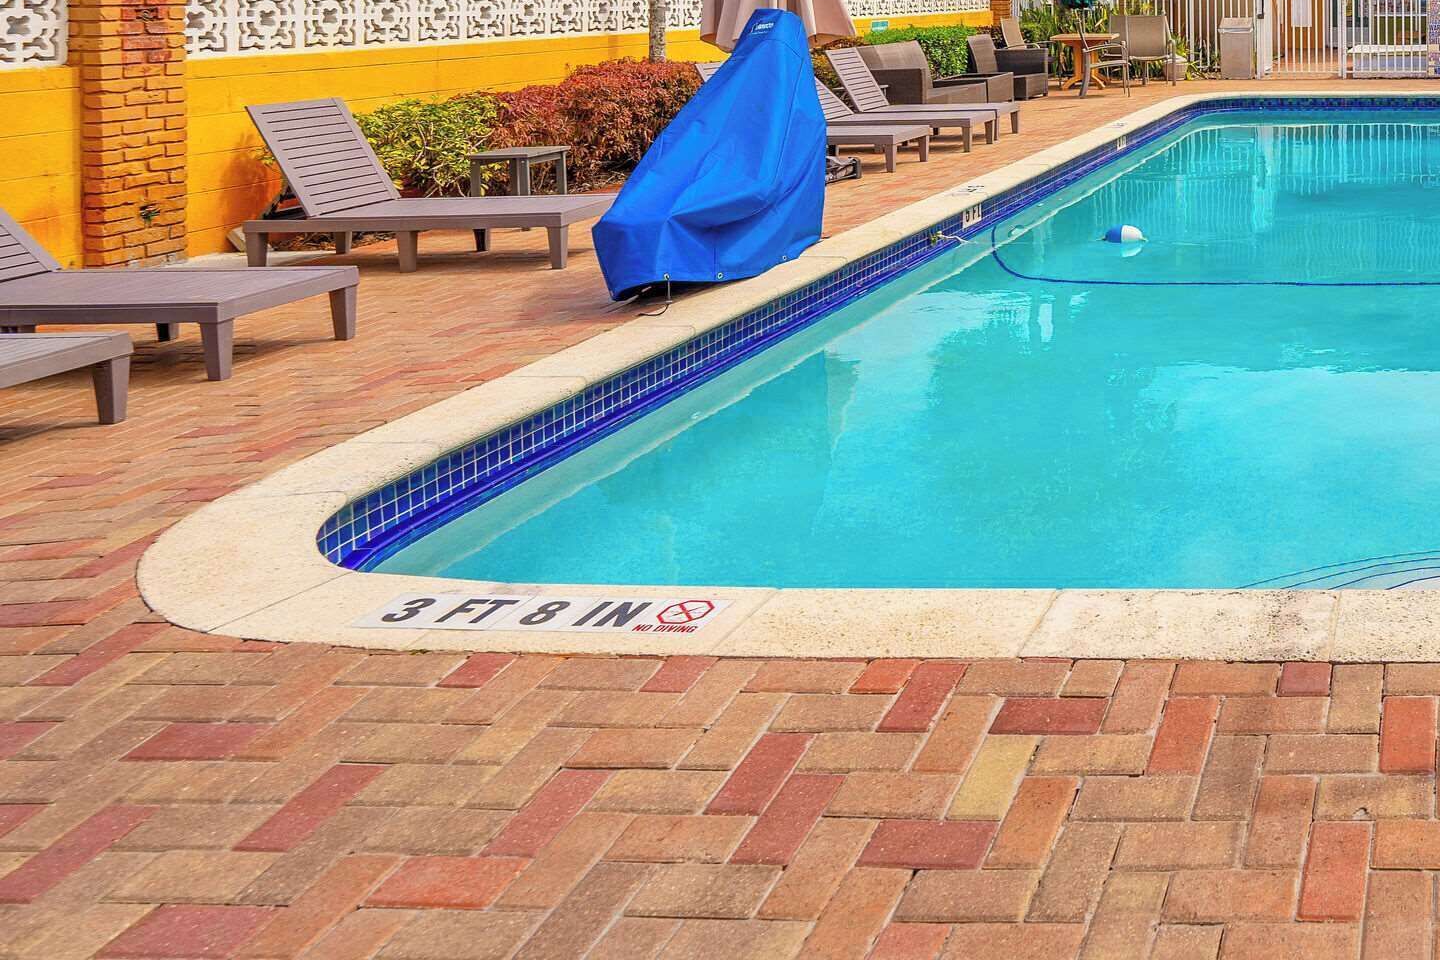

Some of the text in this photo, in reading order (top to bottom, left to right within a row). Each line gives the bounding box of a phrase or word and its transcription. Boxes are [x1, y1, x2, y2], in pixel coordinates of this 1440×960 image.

[381, 597, 653, 628] 3 FT 8 IN
[631, 624, 698, 633] NO DIVING
